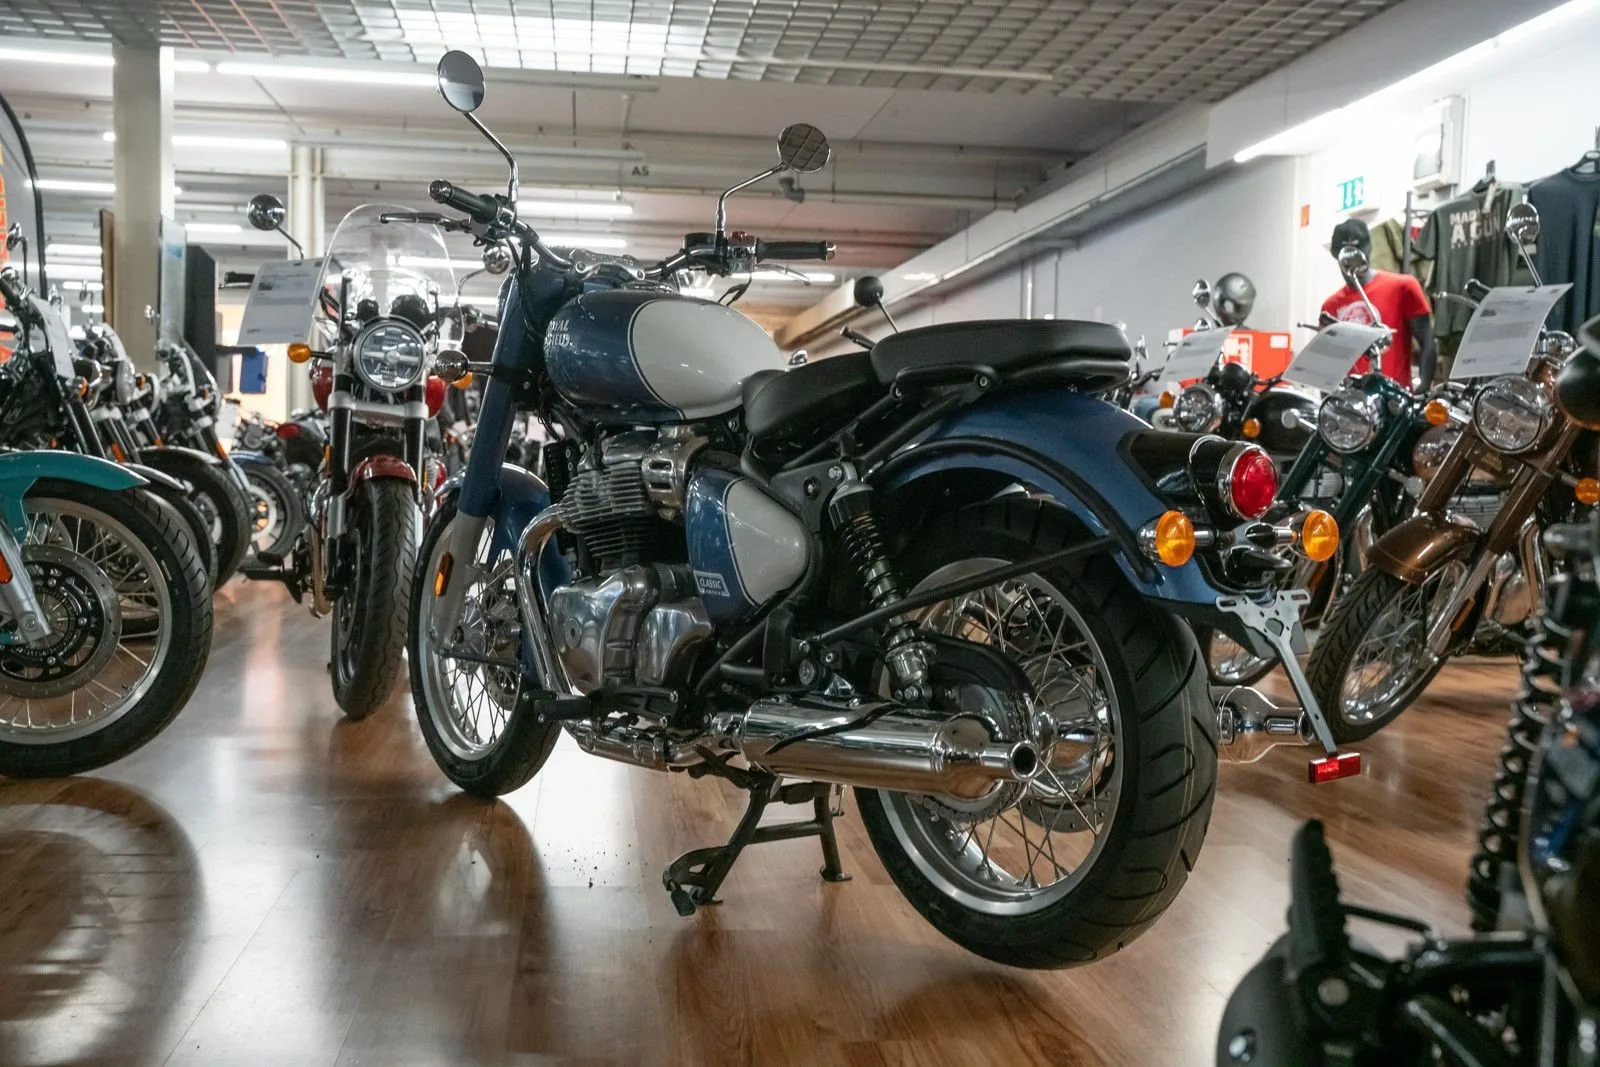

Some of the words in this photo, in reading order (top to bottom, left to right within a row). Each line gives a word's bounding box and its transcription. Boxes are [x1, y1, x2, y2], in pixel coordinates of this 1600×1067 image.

[631, 165, 649, 176] A5
[1449, 209, 1481, 225] MAD
[1451, 223, 1467, 244] A
[547, 319, 570, 332] OYAL
[699, 578, 722, 589] CLASSIC
